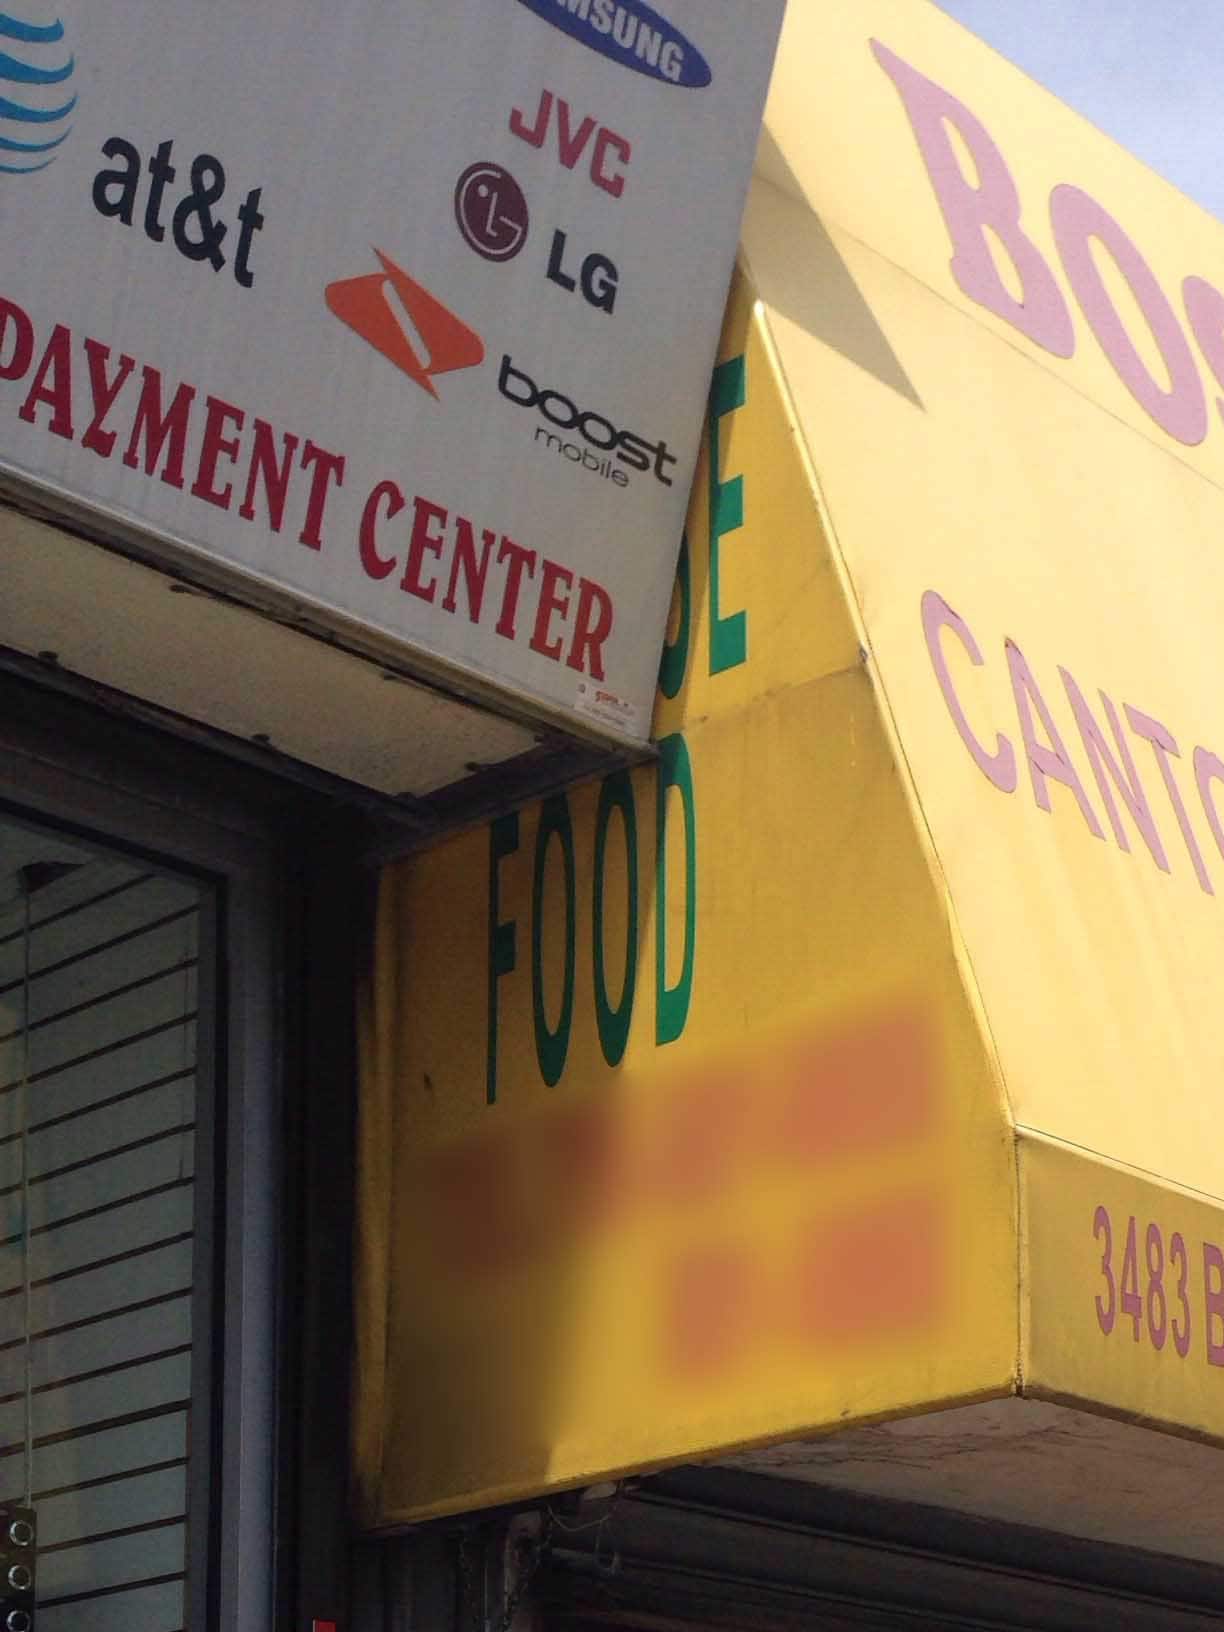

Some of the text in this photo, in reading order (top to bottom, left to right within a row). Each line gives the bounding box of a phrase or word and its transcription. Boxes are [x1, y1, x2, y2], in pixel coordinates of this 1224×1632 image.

[92, 137, 264, 289] at&t
[509, 88, 632, 199] JVC
[546, 228, 619, 315] LG
[498, 356, 678, 487] boost
[535, 426, 630, 489] mobile
[358, 480, 615, 682] CENTER
[487, 732, 696, 1105] FOOD
[1093, 1205, 1192, 1359] 3483
